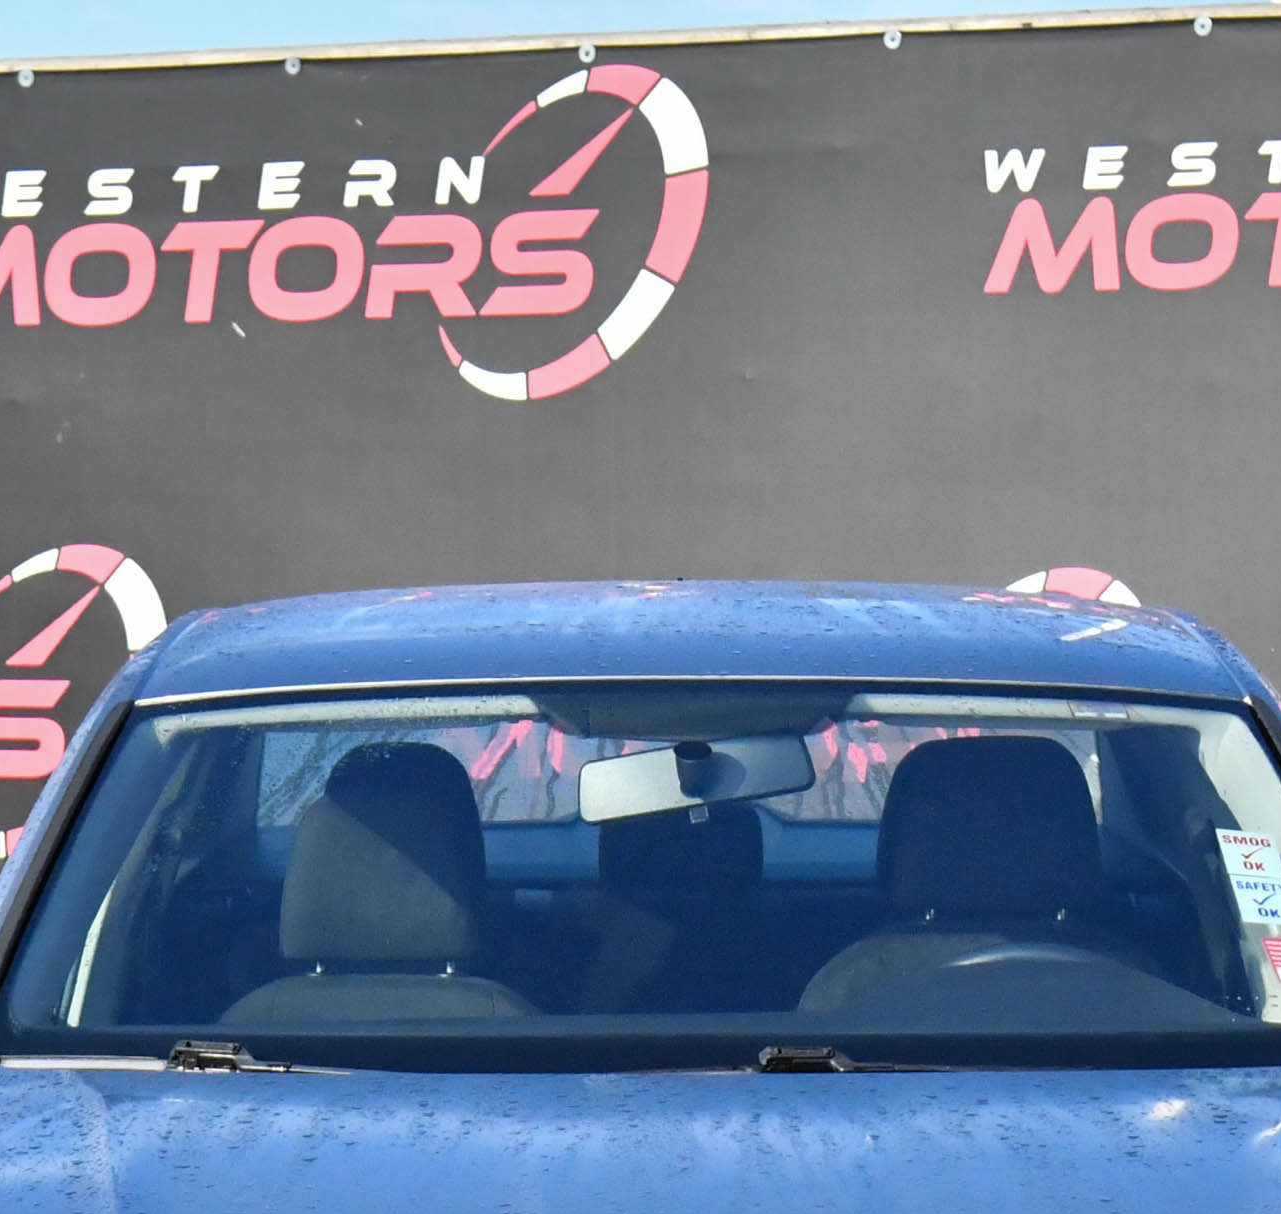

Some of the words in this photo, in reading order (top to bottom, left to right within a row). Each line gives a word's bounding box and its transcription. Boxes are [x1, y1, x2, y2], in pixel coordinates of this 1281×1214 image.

[1221, 834, 1272, 848] SMOG
[1242, 860, 1266, 872] OK
[1257, 907, 1281, 919] OK
